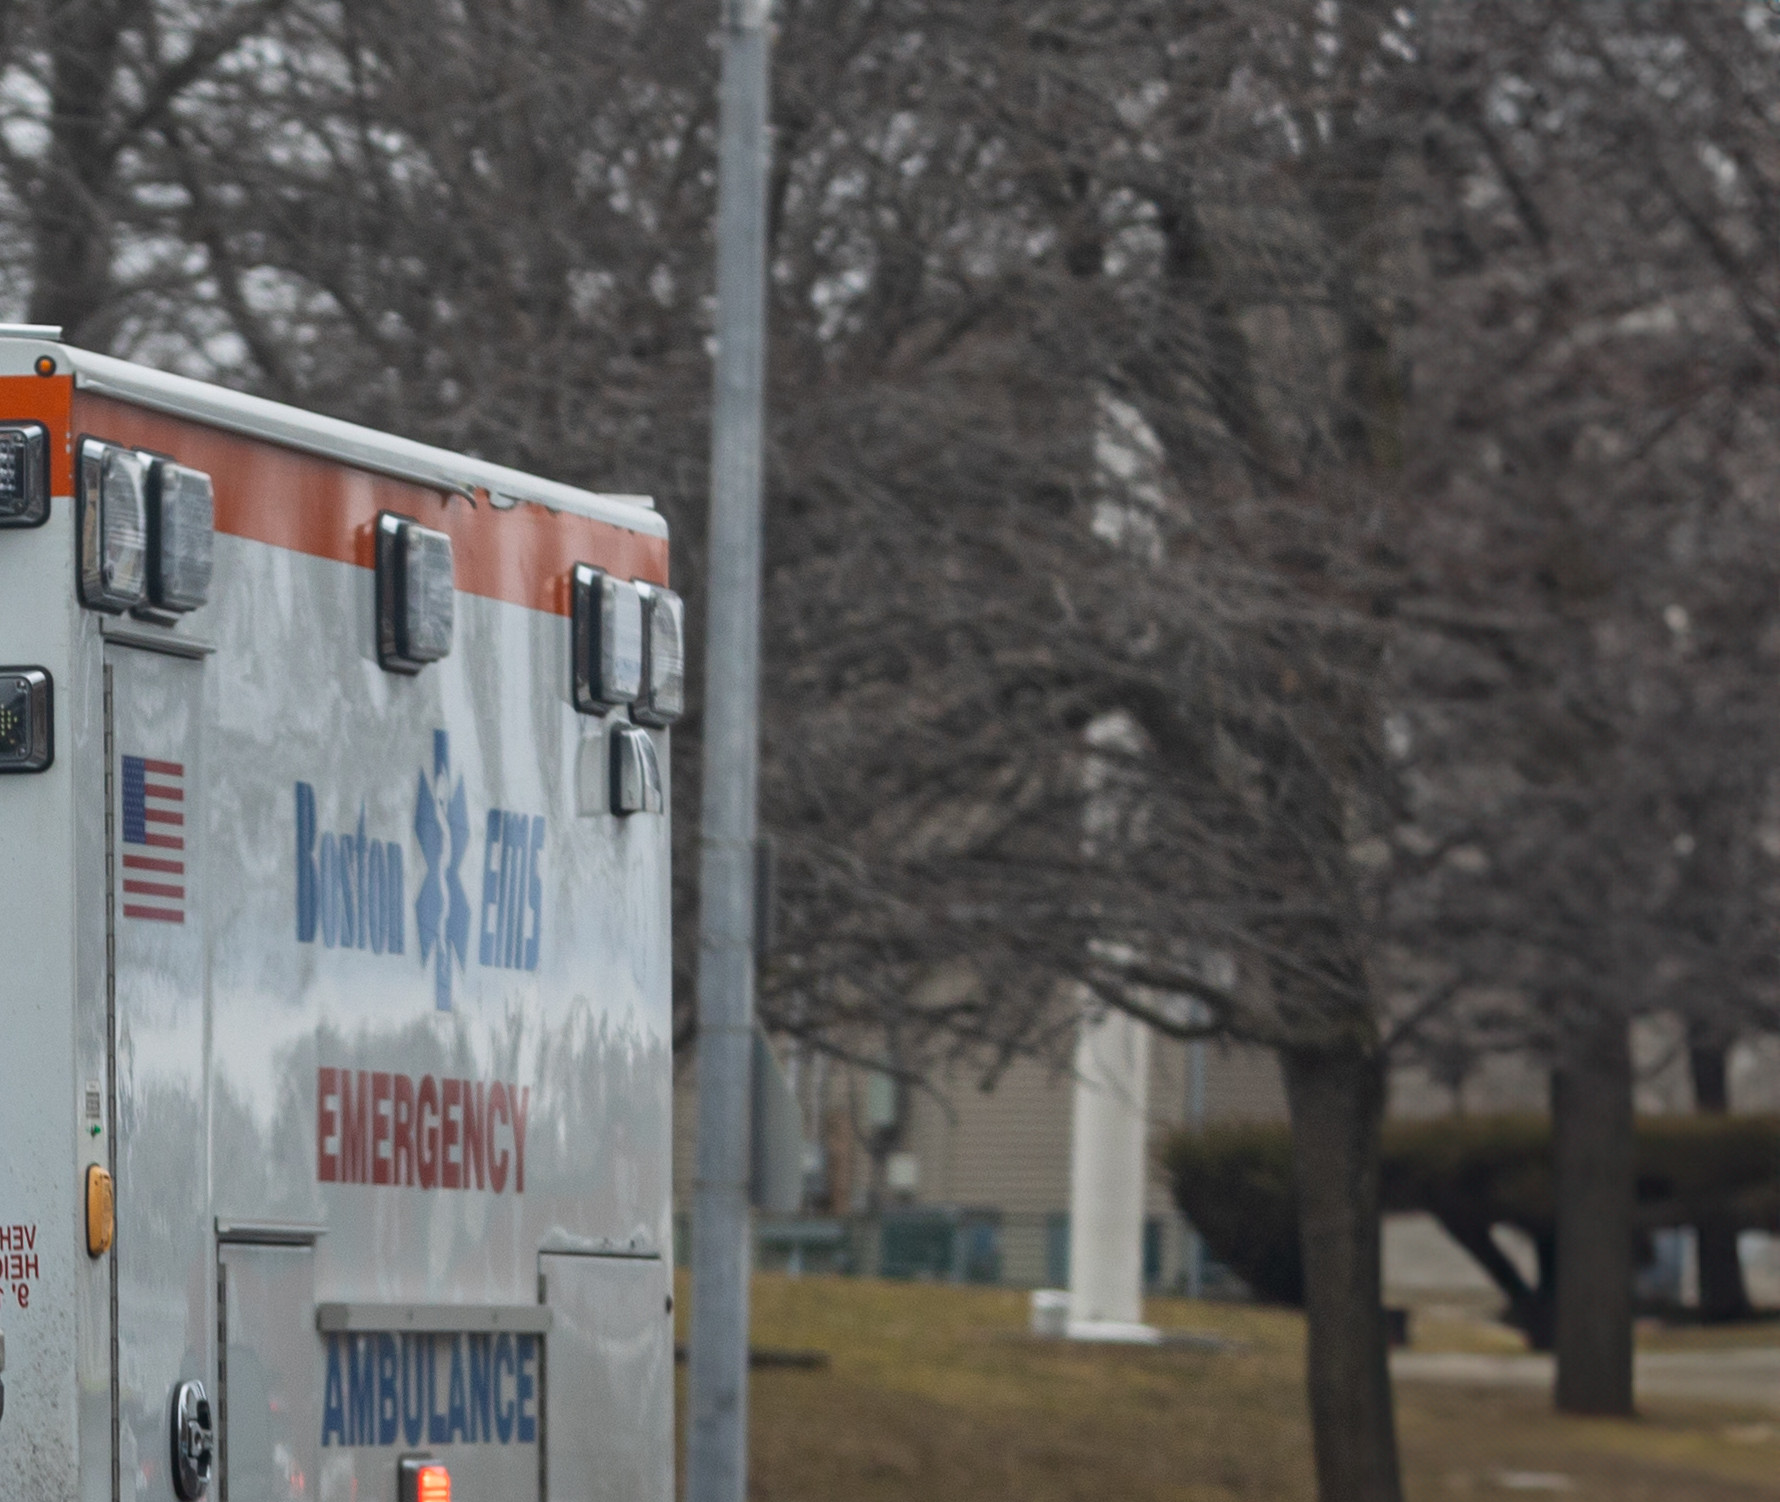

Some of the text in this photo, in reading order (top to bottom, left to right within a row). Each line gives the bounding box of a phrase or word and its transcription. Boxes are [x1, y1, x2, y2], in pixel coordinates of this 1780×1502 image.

[295, 780, 546, 972] Boston EMS
[317, 1066, 531, 1194] EMERGENCY
[321, 1331, 537, 1448] AMBULANCE
